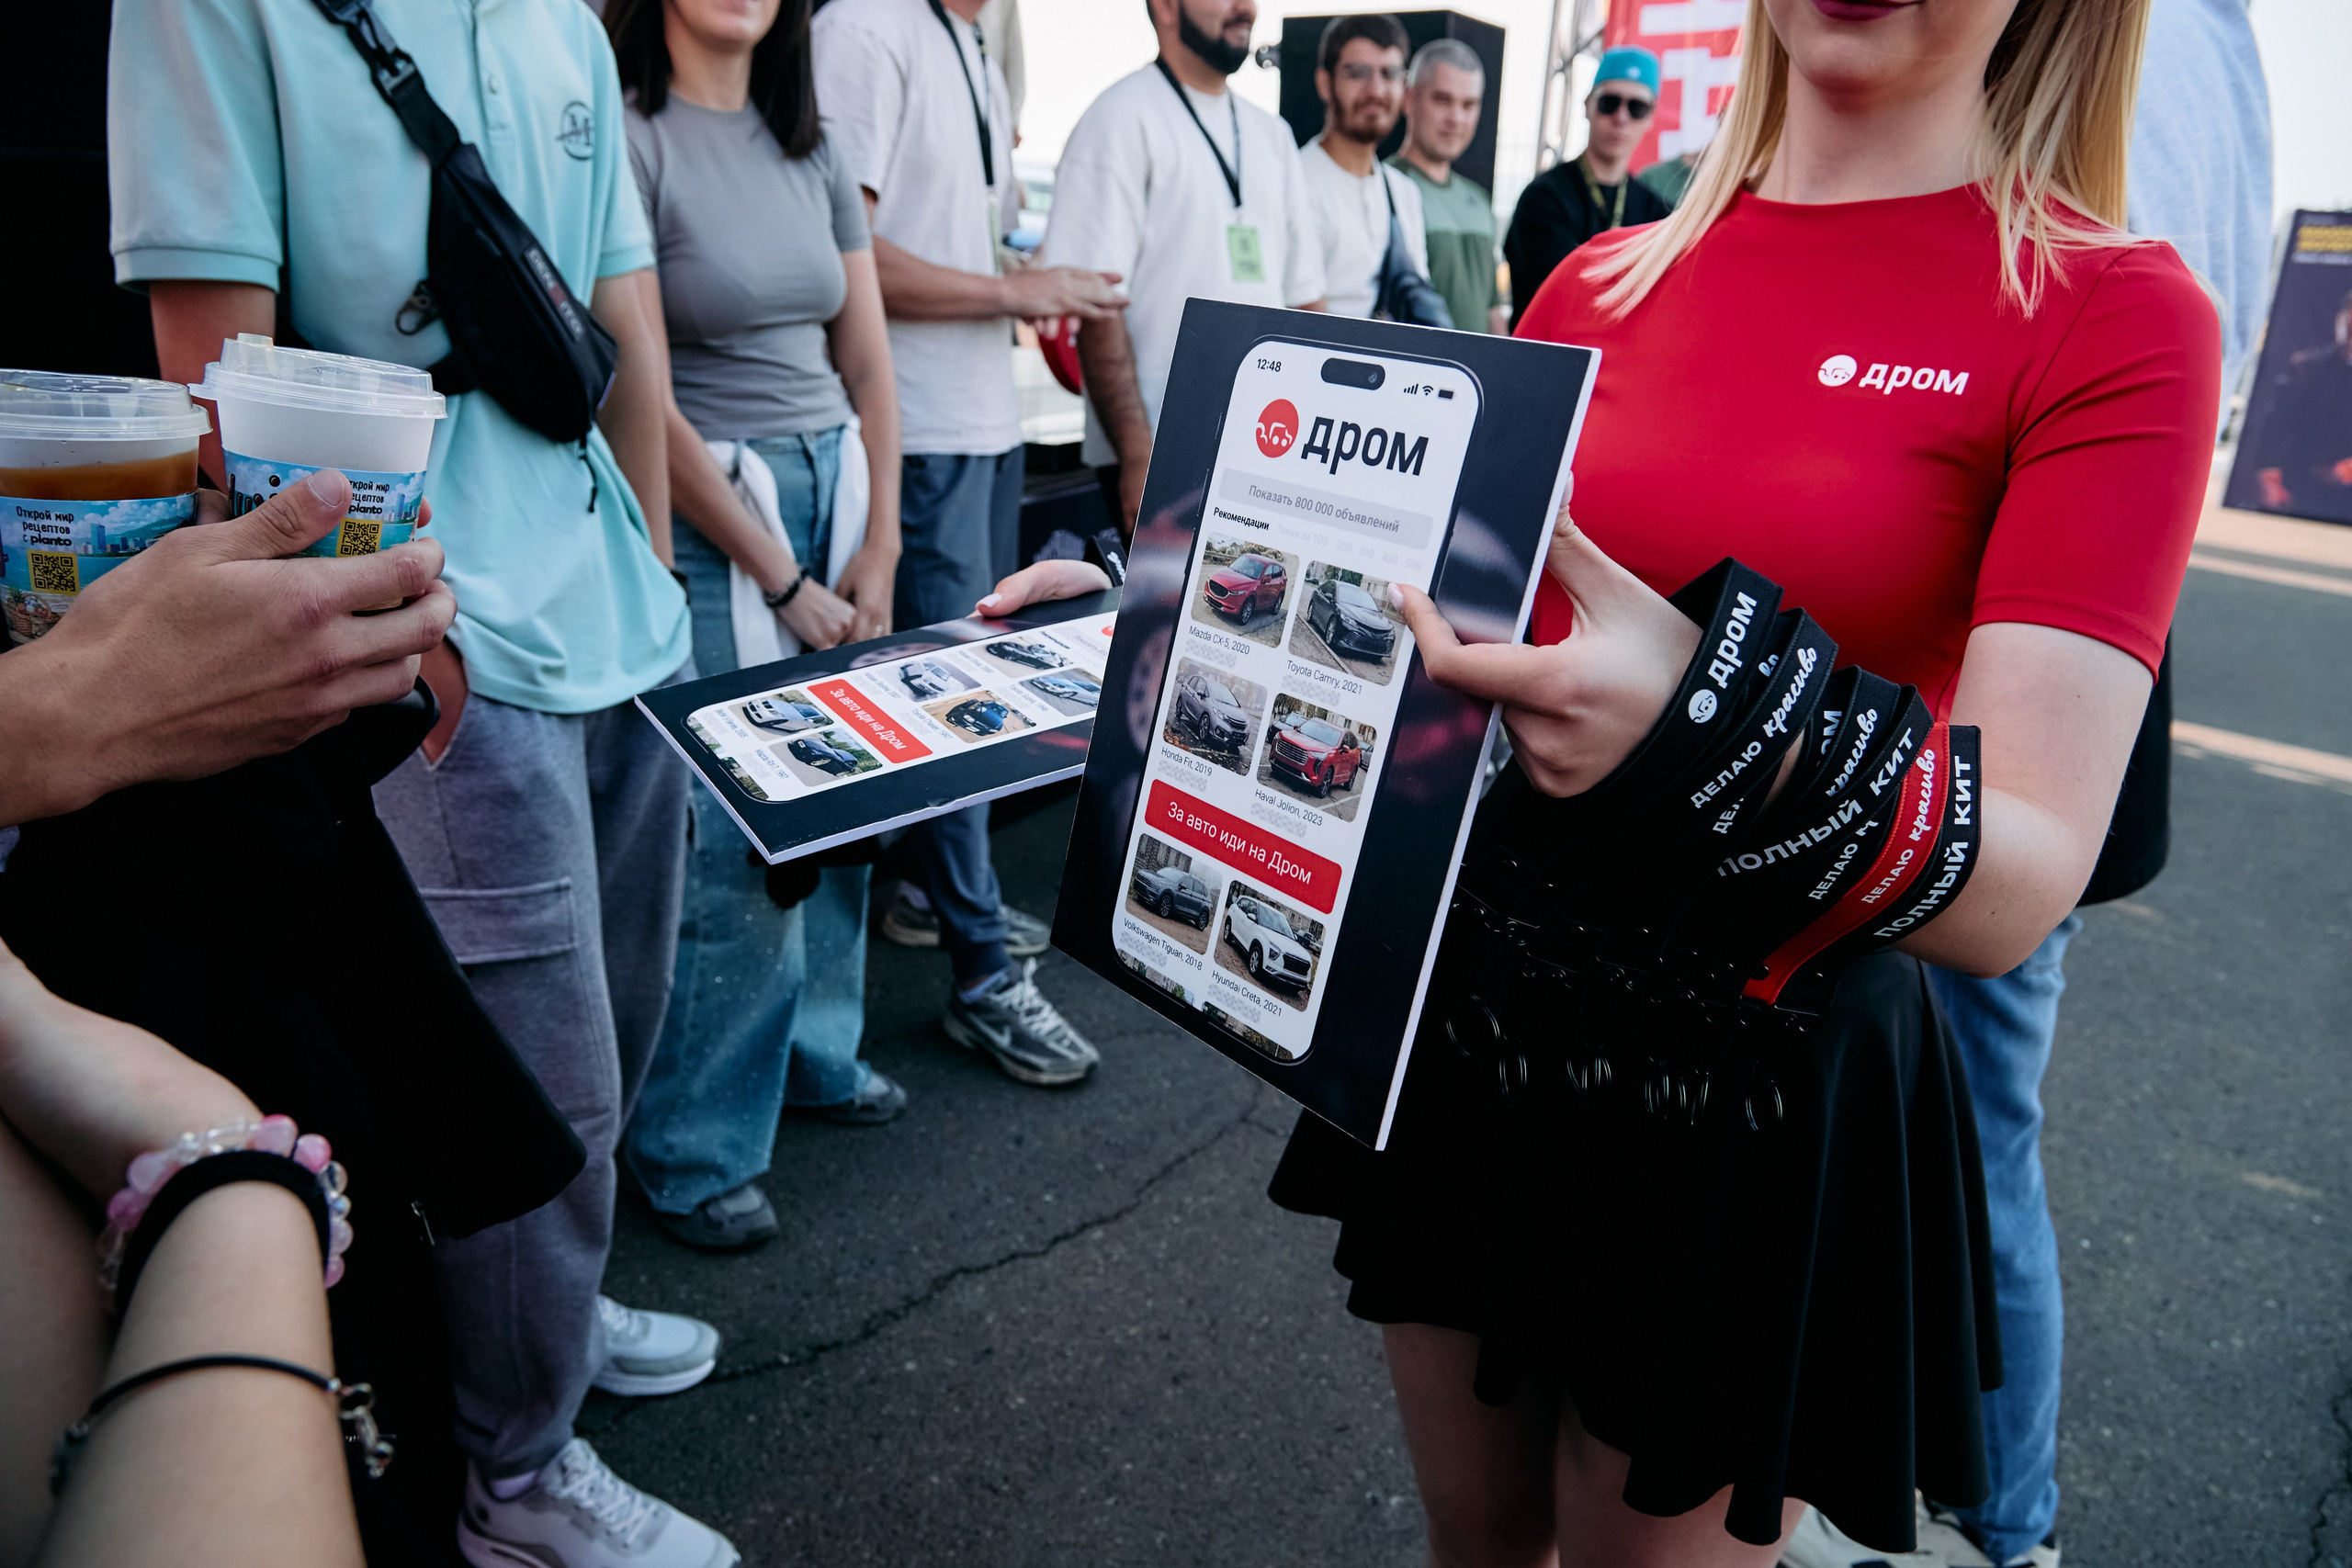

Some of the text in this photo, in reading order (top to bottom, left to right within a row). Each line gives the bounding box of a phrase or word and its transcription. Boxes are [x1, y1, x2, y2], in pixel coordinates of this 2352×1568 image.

[1257, 358, 1282, 373] 12:48
[1858, 363, 1970, 396] дром
[1301, 416, 1430, 476] дром
[376, 483, 390, 493] мир
[17, 505, 74, 524] Открой мир
[348, 502, 383, 514] planto
[1213, 507, 1270, 531] Рекомендации
[1248, 485, 1400, 533] Показать 800 000 объявлений
[22, 522, 71, 535] рецептов
[30, 533, 73, 546] planto
[1314, 535, 1329, 547] 100
[1336, 540, 1352, 553] 200
[1188, 626, 1250, 656] Mazda CX-5, 2020
[1707, 592, 1757, 689] дром
[1286, 660, 1363, 695] Toyota Camry, 2021
[830, 689, 908, 750] За авто иди на Дром
[1690, 740, 1762, 808] ДЕЛАЮ
[1762, 647, 1817, 738] красиво
[1161, 747, 1213, 776] Honda Fit, 2019
[1255, 788, 1323, 827] Haval Jolion, 2023
[1717, 799, 1863, 876] ПОЛНЫЙ
[1870, 728, 1913, 796] КИТ
[1168, 801, 1312, 885] За авто иди на Дром
[1861, 849, 1914, 904] ДЕЛАЮ
[1908, 749, 1936, 841] красиво
[1873, 755, 1972, 937] ПОЛНЫЙ КИТ
[1808, 843, 1859, 900] ДЕЛАЮ
[1124, 918, 1204, 971] Volkswagen Tiguan, 2018
[1211, 970, 1283, 1017] Hyundai Creta, 2021
